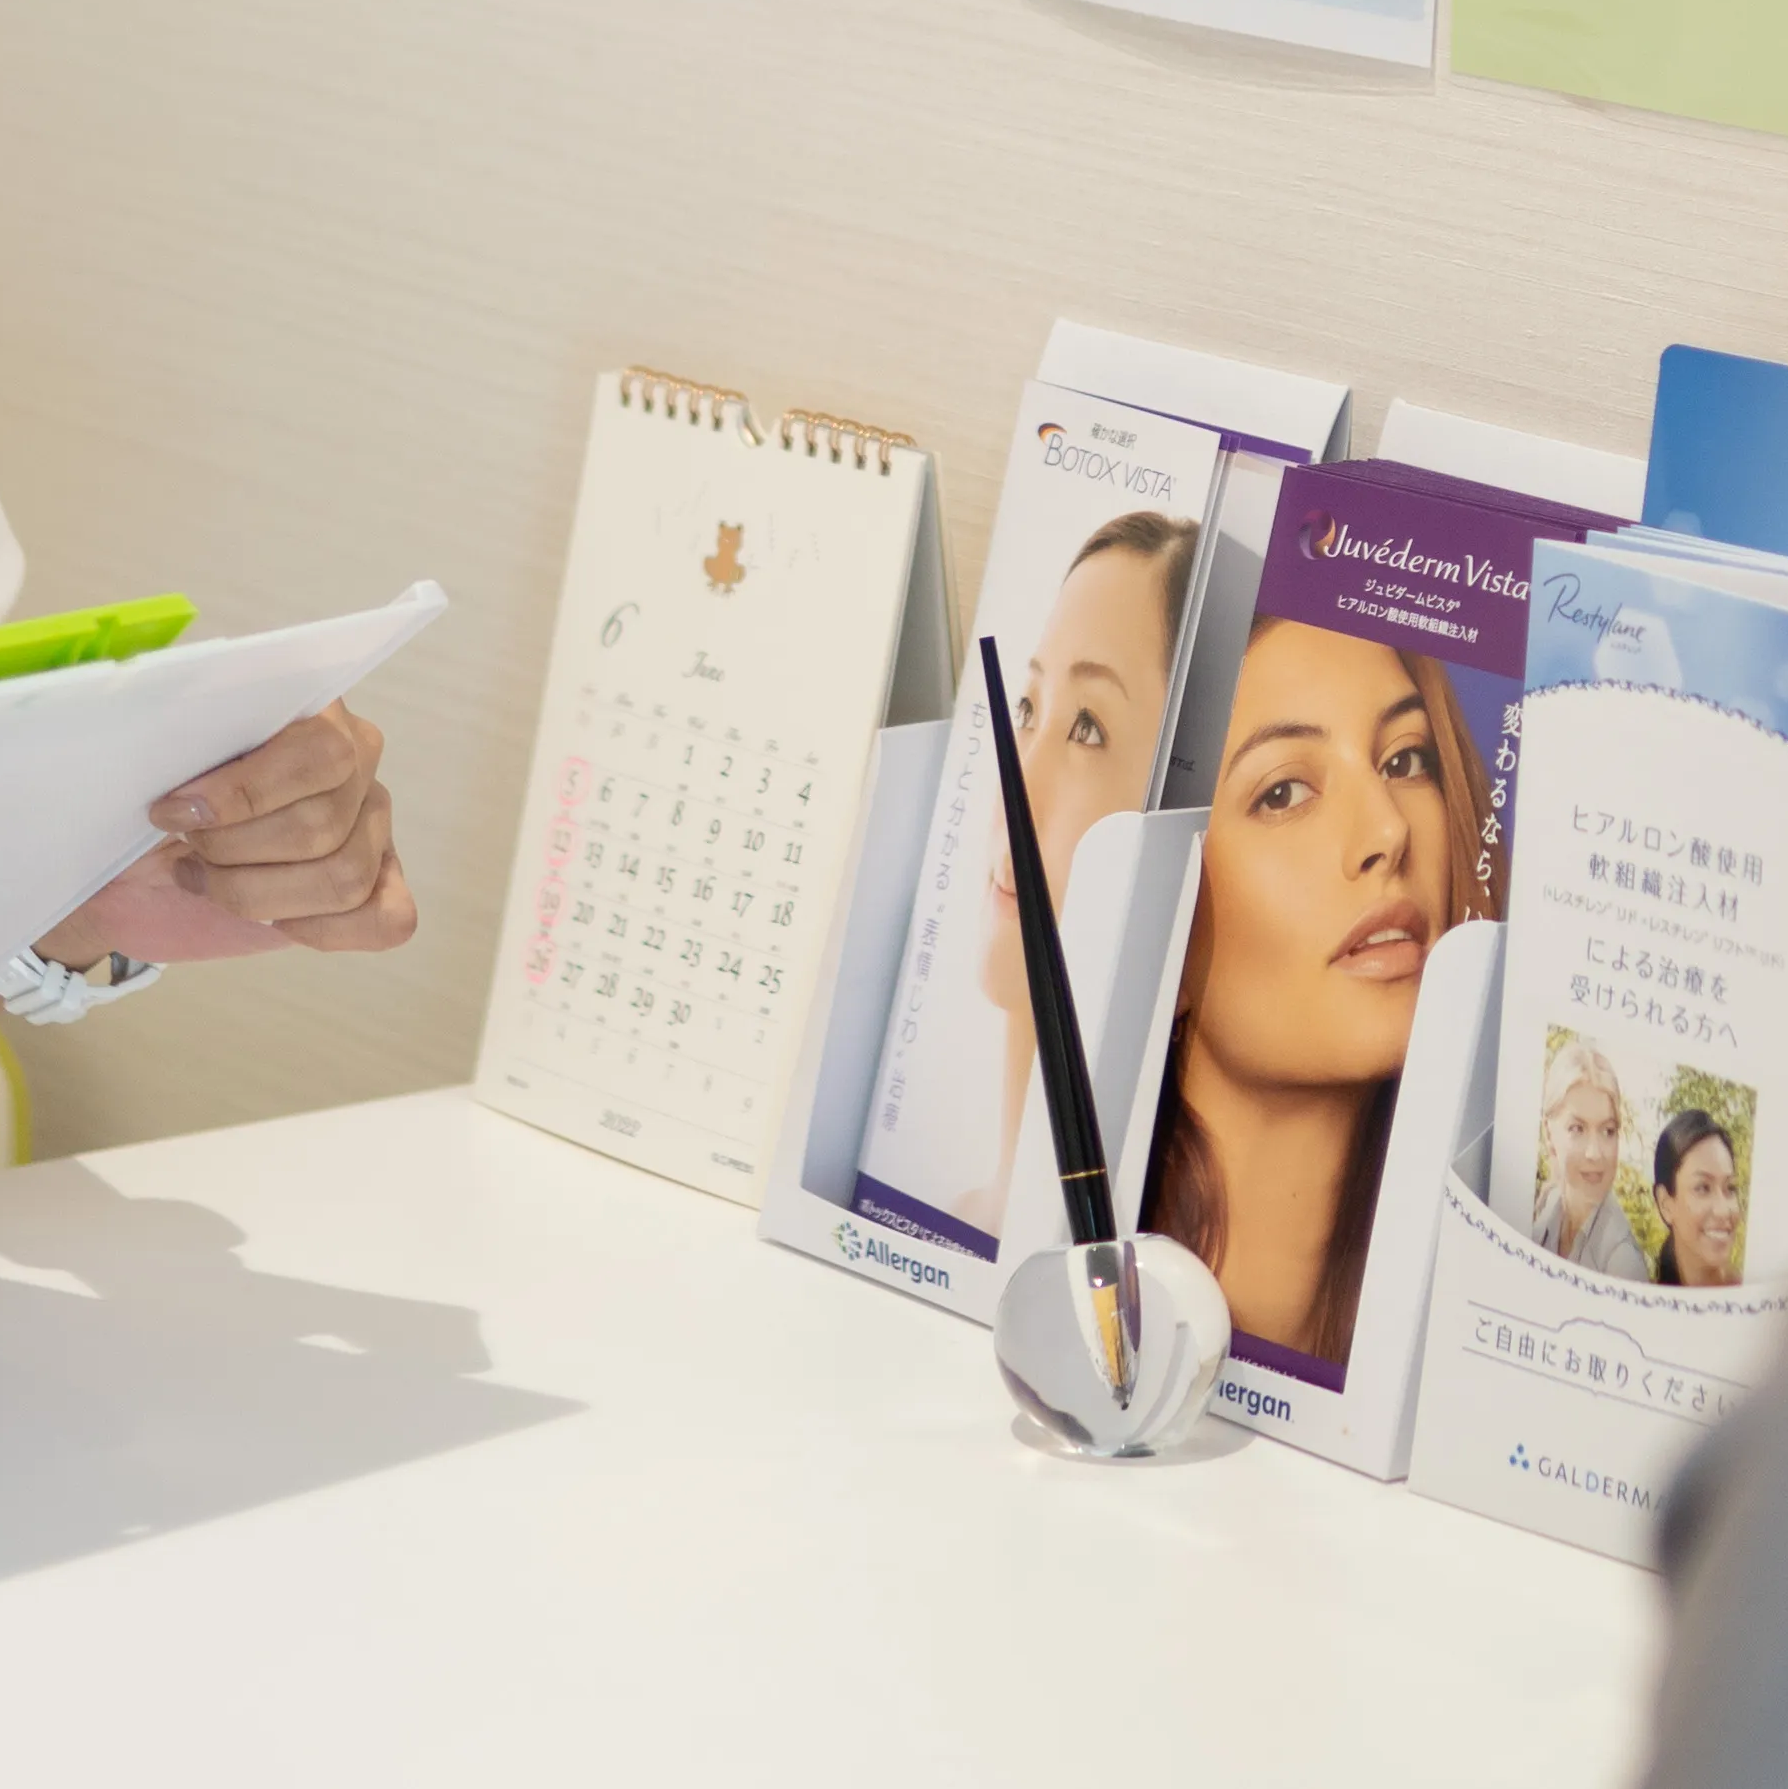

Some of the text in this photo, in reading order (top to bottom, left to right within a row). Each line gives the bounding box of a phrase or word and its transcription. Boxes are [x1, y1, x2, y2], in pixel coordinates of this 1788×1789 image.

[1044, 433, 1119, 486] BOTOX
[1091, 423, 1138, 449] 確かな選択
[601, 603, 640, 648] 6
[684, 745, 812, 806] 1 2 3 4
[599, 777, 615, 802] 6
[632, 793, 649, 818] 7
[671, 800, 685, 826] 8
[704, 819, 721, 844] 9
[742, 829, 765, 852] 10
[783, 842, 803, 864] 11
[1572, 804, 1764, 886] ヒアルロン酸使用
[586, 841, 604, 868] 13
[618, 853, 640, 881] 14
[656, 866, 677, 893] 15
[693, 876, 717, 901] 16
[730, 891, 754, 918] 17
[771, 901, 795, 926] 18
[1588, 853, 1739, 922] 軟組織注入材
[607, 914, 628, 938] 21
[642, 926, 666, 950] 22
[680, 939, 703, 968] 23
[717, 951, 742, 981] 24
[759, 965, 784, 994] 25
[1586, 936, 1729, 1004] による治療を
[561, 960, 585, 989] 27
[594, 972, 620, 998] 28
[630, 986, 654, 1017] 29
[667, 1000, 691, 1026] 30
[1569, 975, 1739, 1048] 受けられる方へ
[865, 1238, 950, 1290] Allergan
